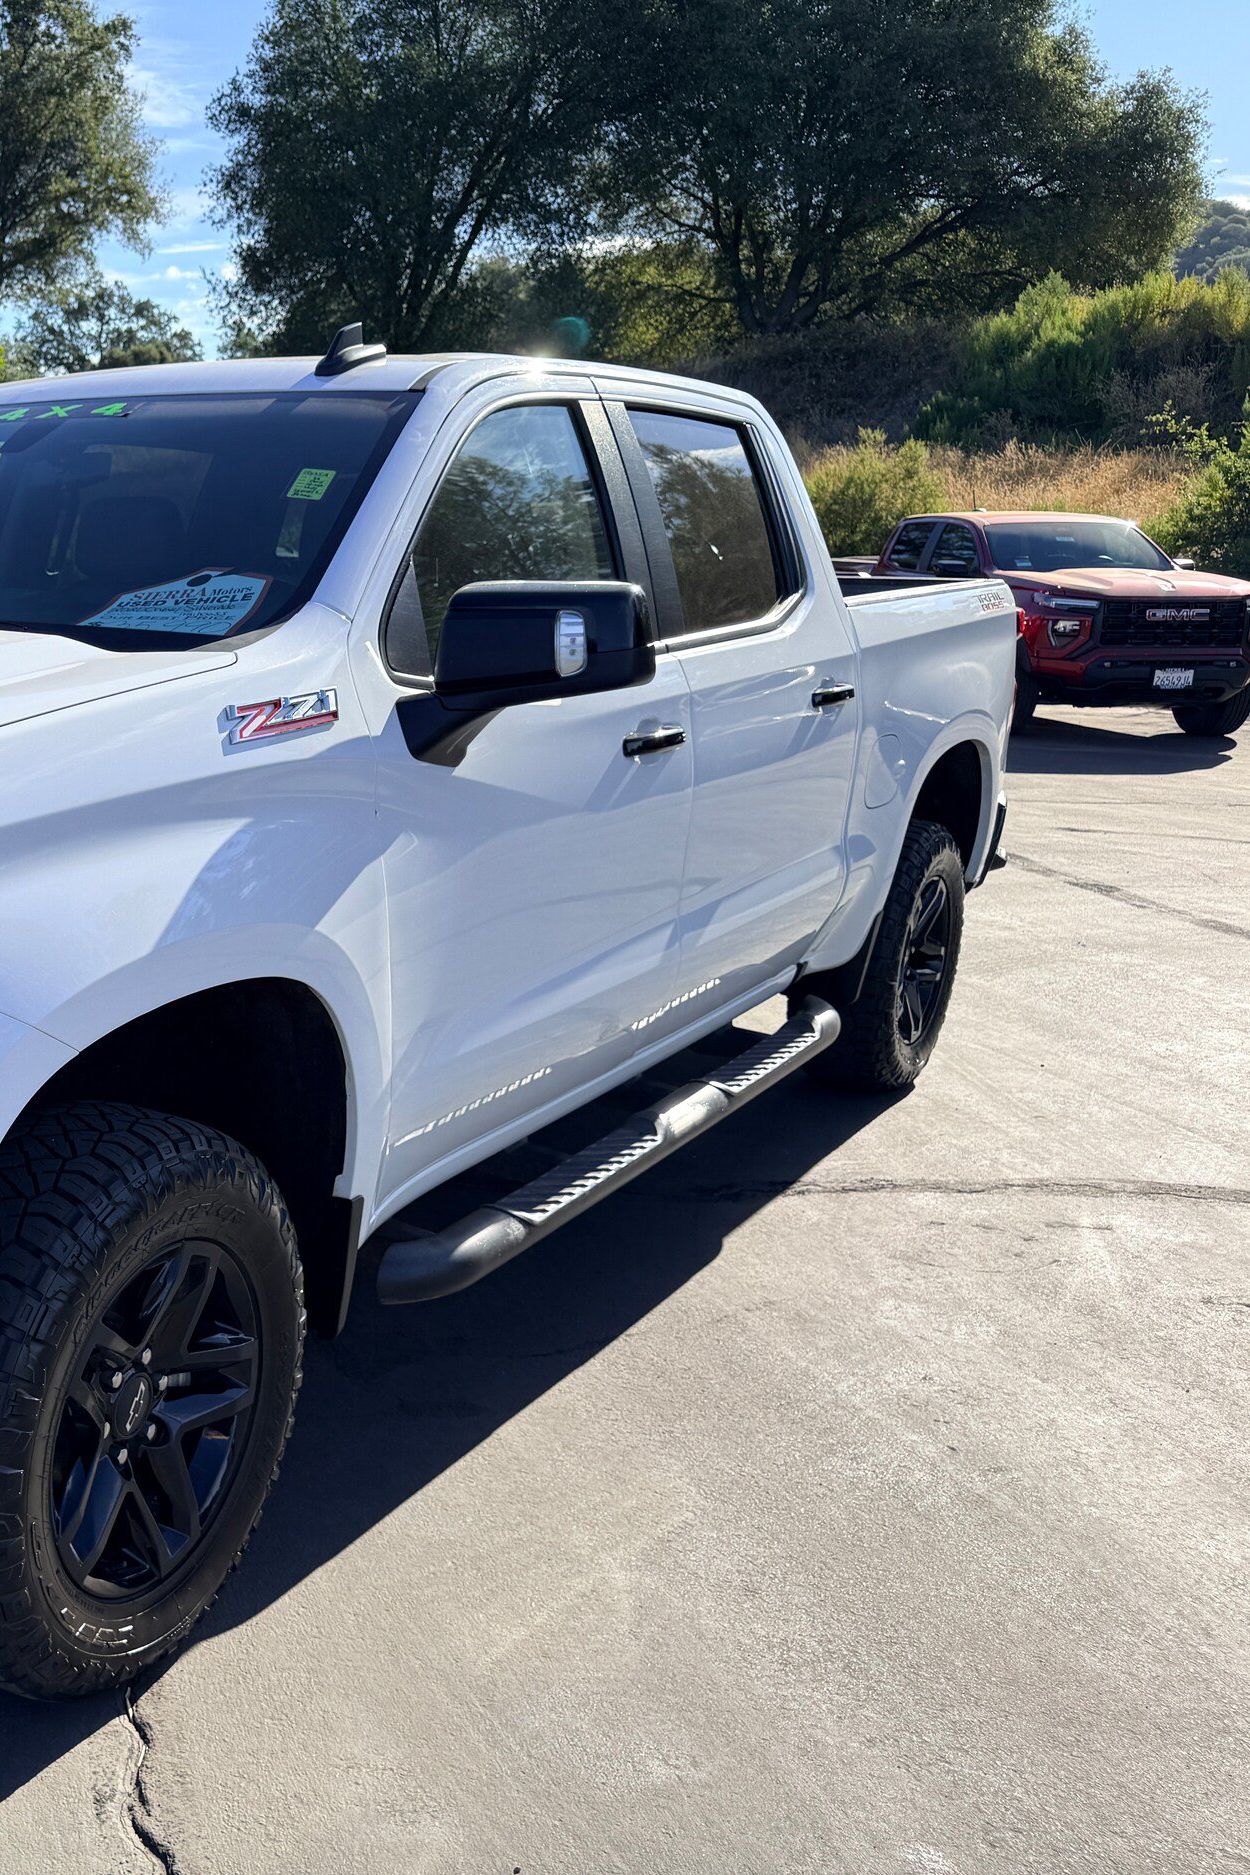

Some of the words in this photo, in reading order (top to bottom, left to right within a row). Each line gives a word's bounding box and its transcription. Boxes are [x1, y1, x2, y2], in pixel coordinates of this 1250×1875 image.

[117, 599, 168, 608] USED
[173, 592, 255, 606] VEHICLE
[131, 586, 207, 601] SIERRA
[210, 585, 253, 596] Motors
[973, 591, 1005, 604] TRAIL
[980, 600, 1005, 612] BOSS
[1145, 608, 1211, 621] GMC
[225, 686, 340, 746] Z71
